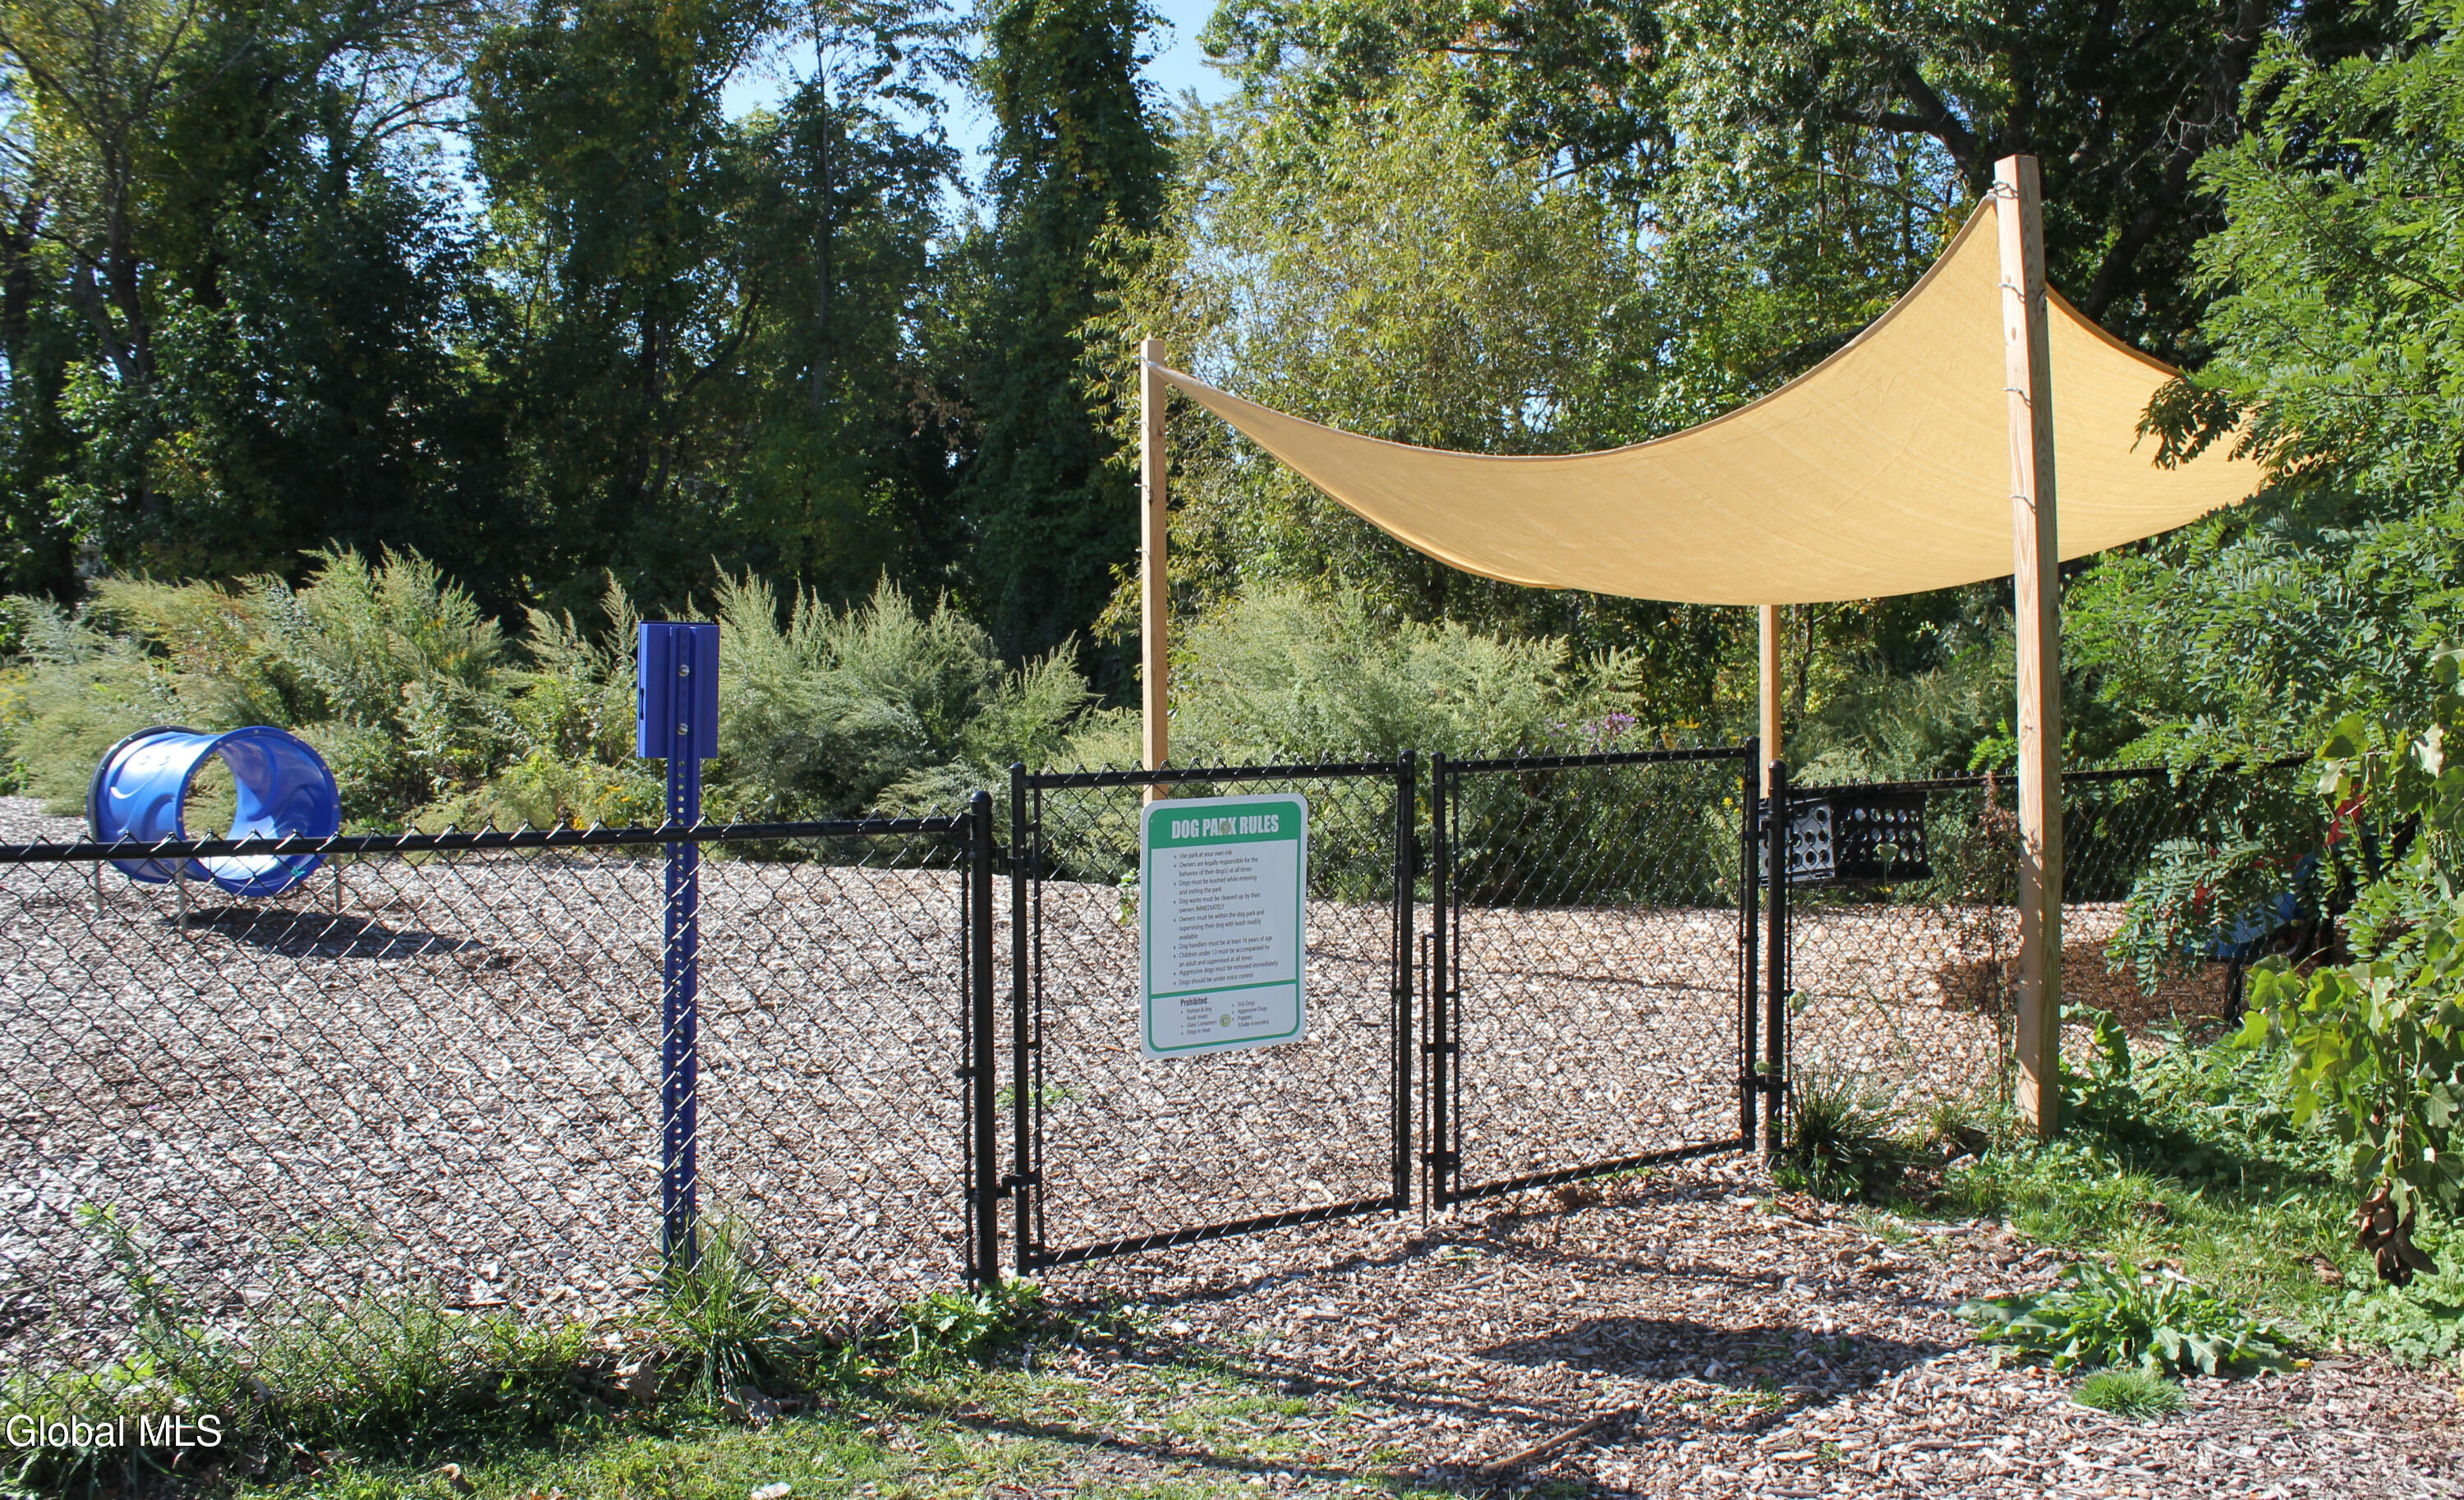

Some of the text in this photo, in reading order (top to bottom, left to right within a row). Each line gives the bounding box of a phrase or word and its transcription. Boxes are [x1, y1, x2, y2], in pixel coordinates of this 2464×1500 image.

[1172, 819, 1199, 840] DOG
[1239, 814, 1279, 835] RULES
[1236, 945, 1264, 953] accompanied
